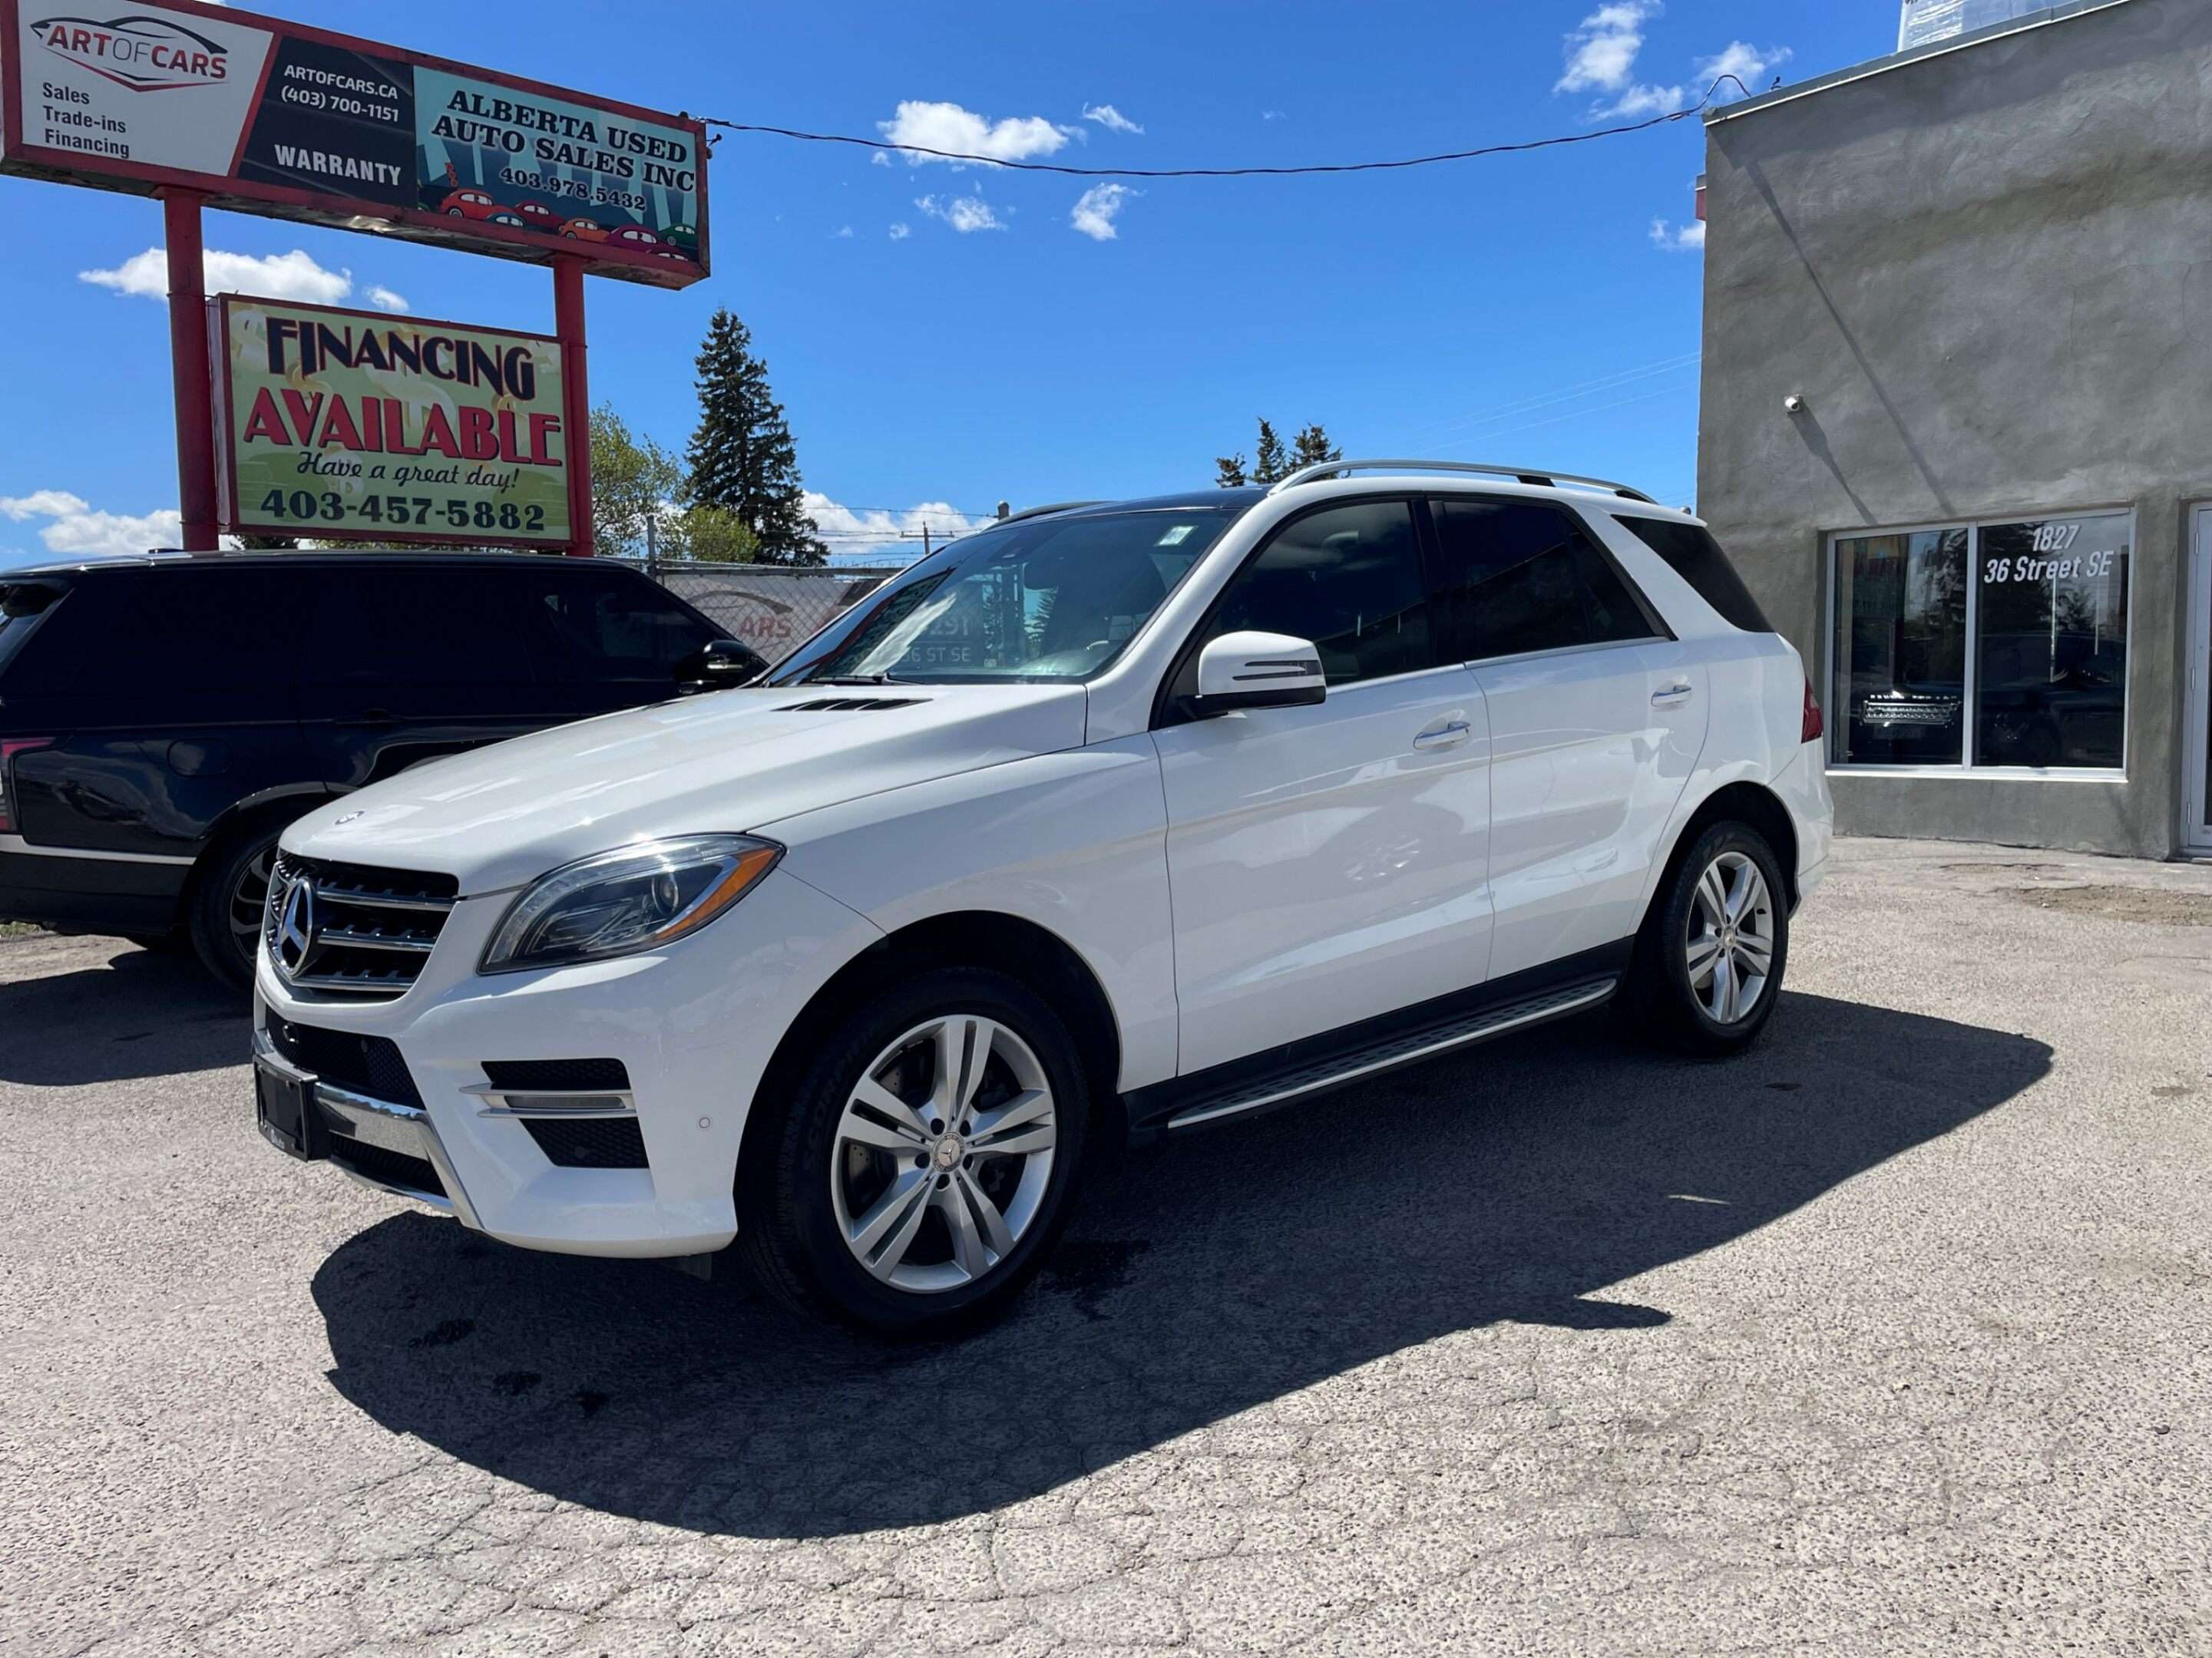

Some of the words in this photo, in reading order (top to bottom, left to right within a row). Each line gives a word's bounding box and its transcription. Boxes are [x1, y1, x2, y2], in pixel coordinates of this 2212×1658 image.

[47, 25, 226, 78] ARTOFCARS
[43, 82, 90, 104] Sales
[284, 64, 398, 99] ARTOFCARS.CA
[43, 105, 127, 134] Trade-ins
[282, 85, 326, 109] (403)
[330, 96, 398, 121] 700-1151
[45, 128, 130, 159] Financing
[447, 90, 598, 144] ALBERTA
[607, 126, 687, 163] USED
[275, 144, 402, 186] WARRANTY
[431, 115, 525, 153] AUTO
[535, 138, 634, 177] SALES
[643, 162, 695, 191] INC
[501, 167, 646, 212] 403.978.5432
[266, 317, 536, 401] FINANCING
[243, 388, 563, 467] AVAILABLE
[296, 451, 362, 478] Have
[369, 464, 385, 481] a
[392, 464, 459, 491] great
[465, 465, 520, 491] day!
[260, 490, 544, 531] 403-457-5882
[2032, 524, 2081, 552] 1827
[1984, 558, 2010, 583] 36
[2014, 554, 2081, 582] Street
[2085, 551, 2114, 577] SE
[951, 647, 970, 662] SE
